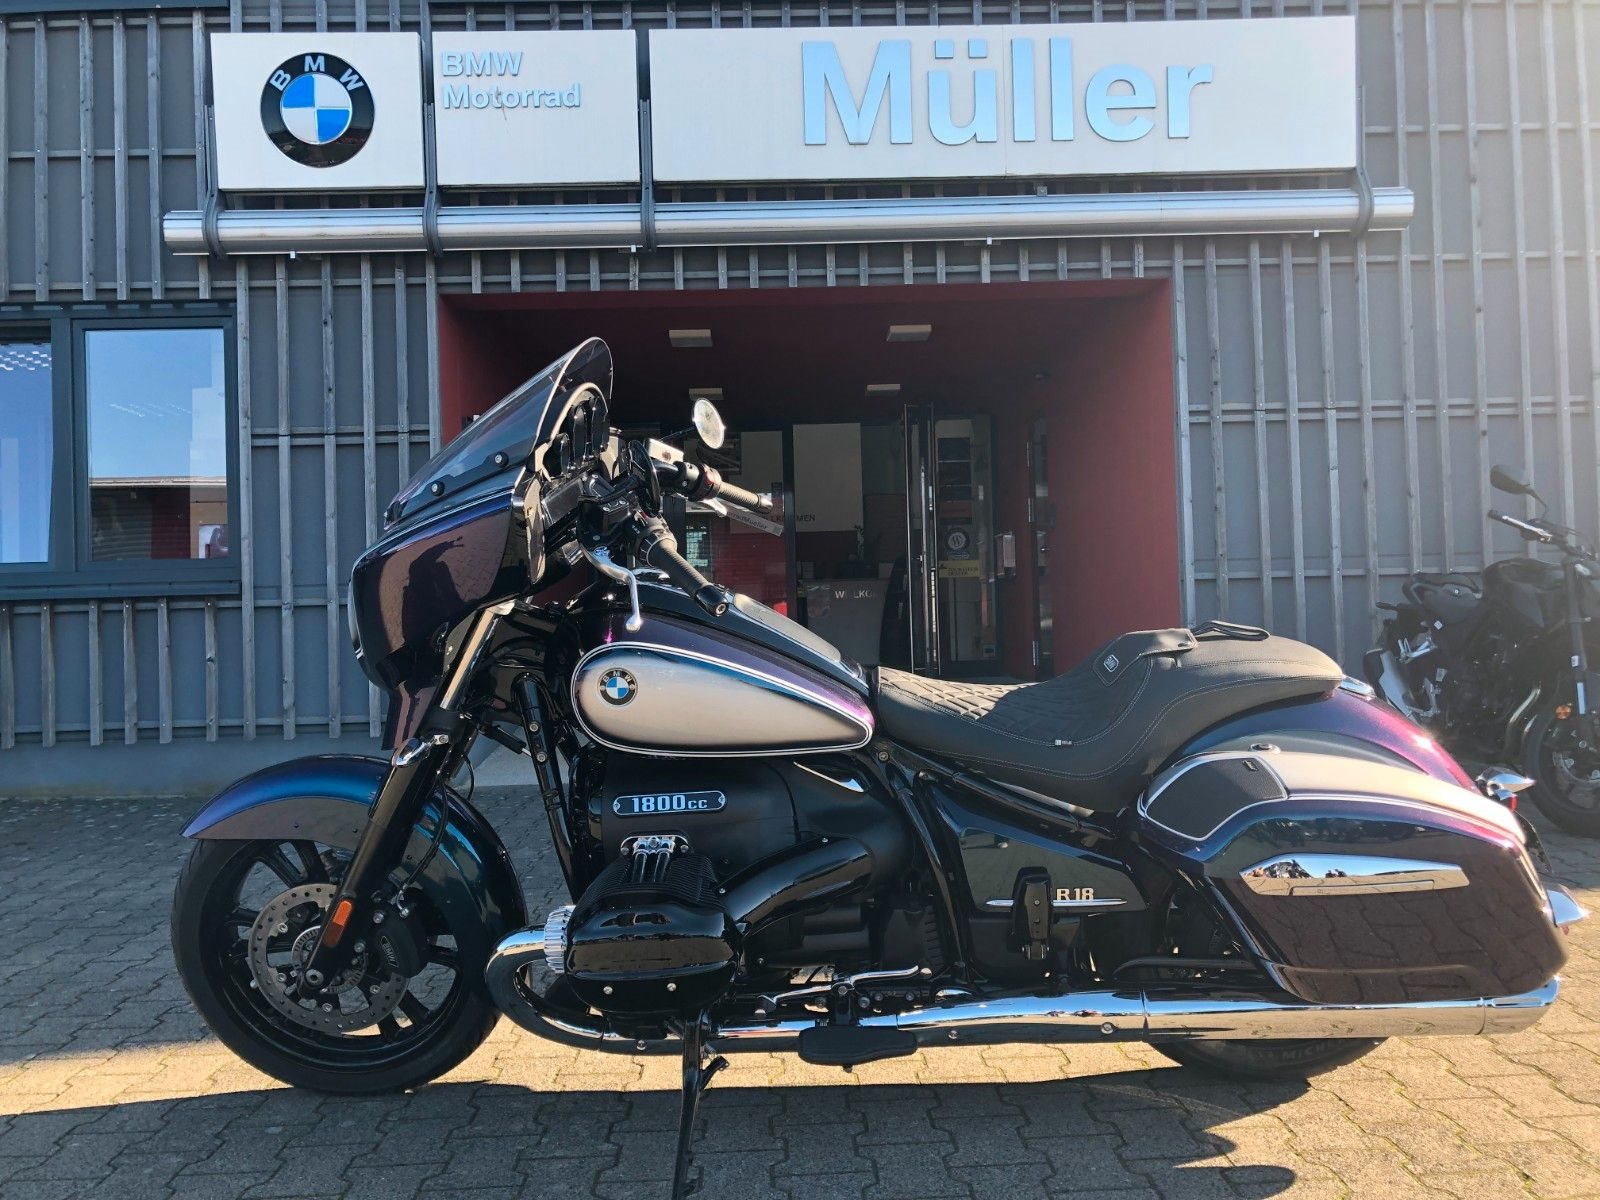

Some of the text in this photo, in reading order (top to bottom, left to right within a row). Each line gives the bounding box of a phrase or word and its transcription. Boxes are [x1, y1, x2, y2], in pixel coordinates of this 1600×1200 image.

[269, 55, 363, 92] BMW
[441, 51, 523, 77] BMW
[442, 82, 581, 109] Motorrad
[801, 37, 1214, 146] Müller
[602, 670, 633, 683] BMW
[631, 794, 708, 813] 1800cc
[1056, 887, 1095, 901] R 18
